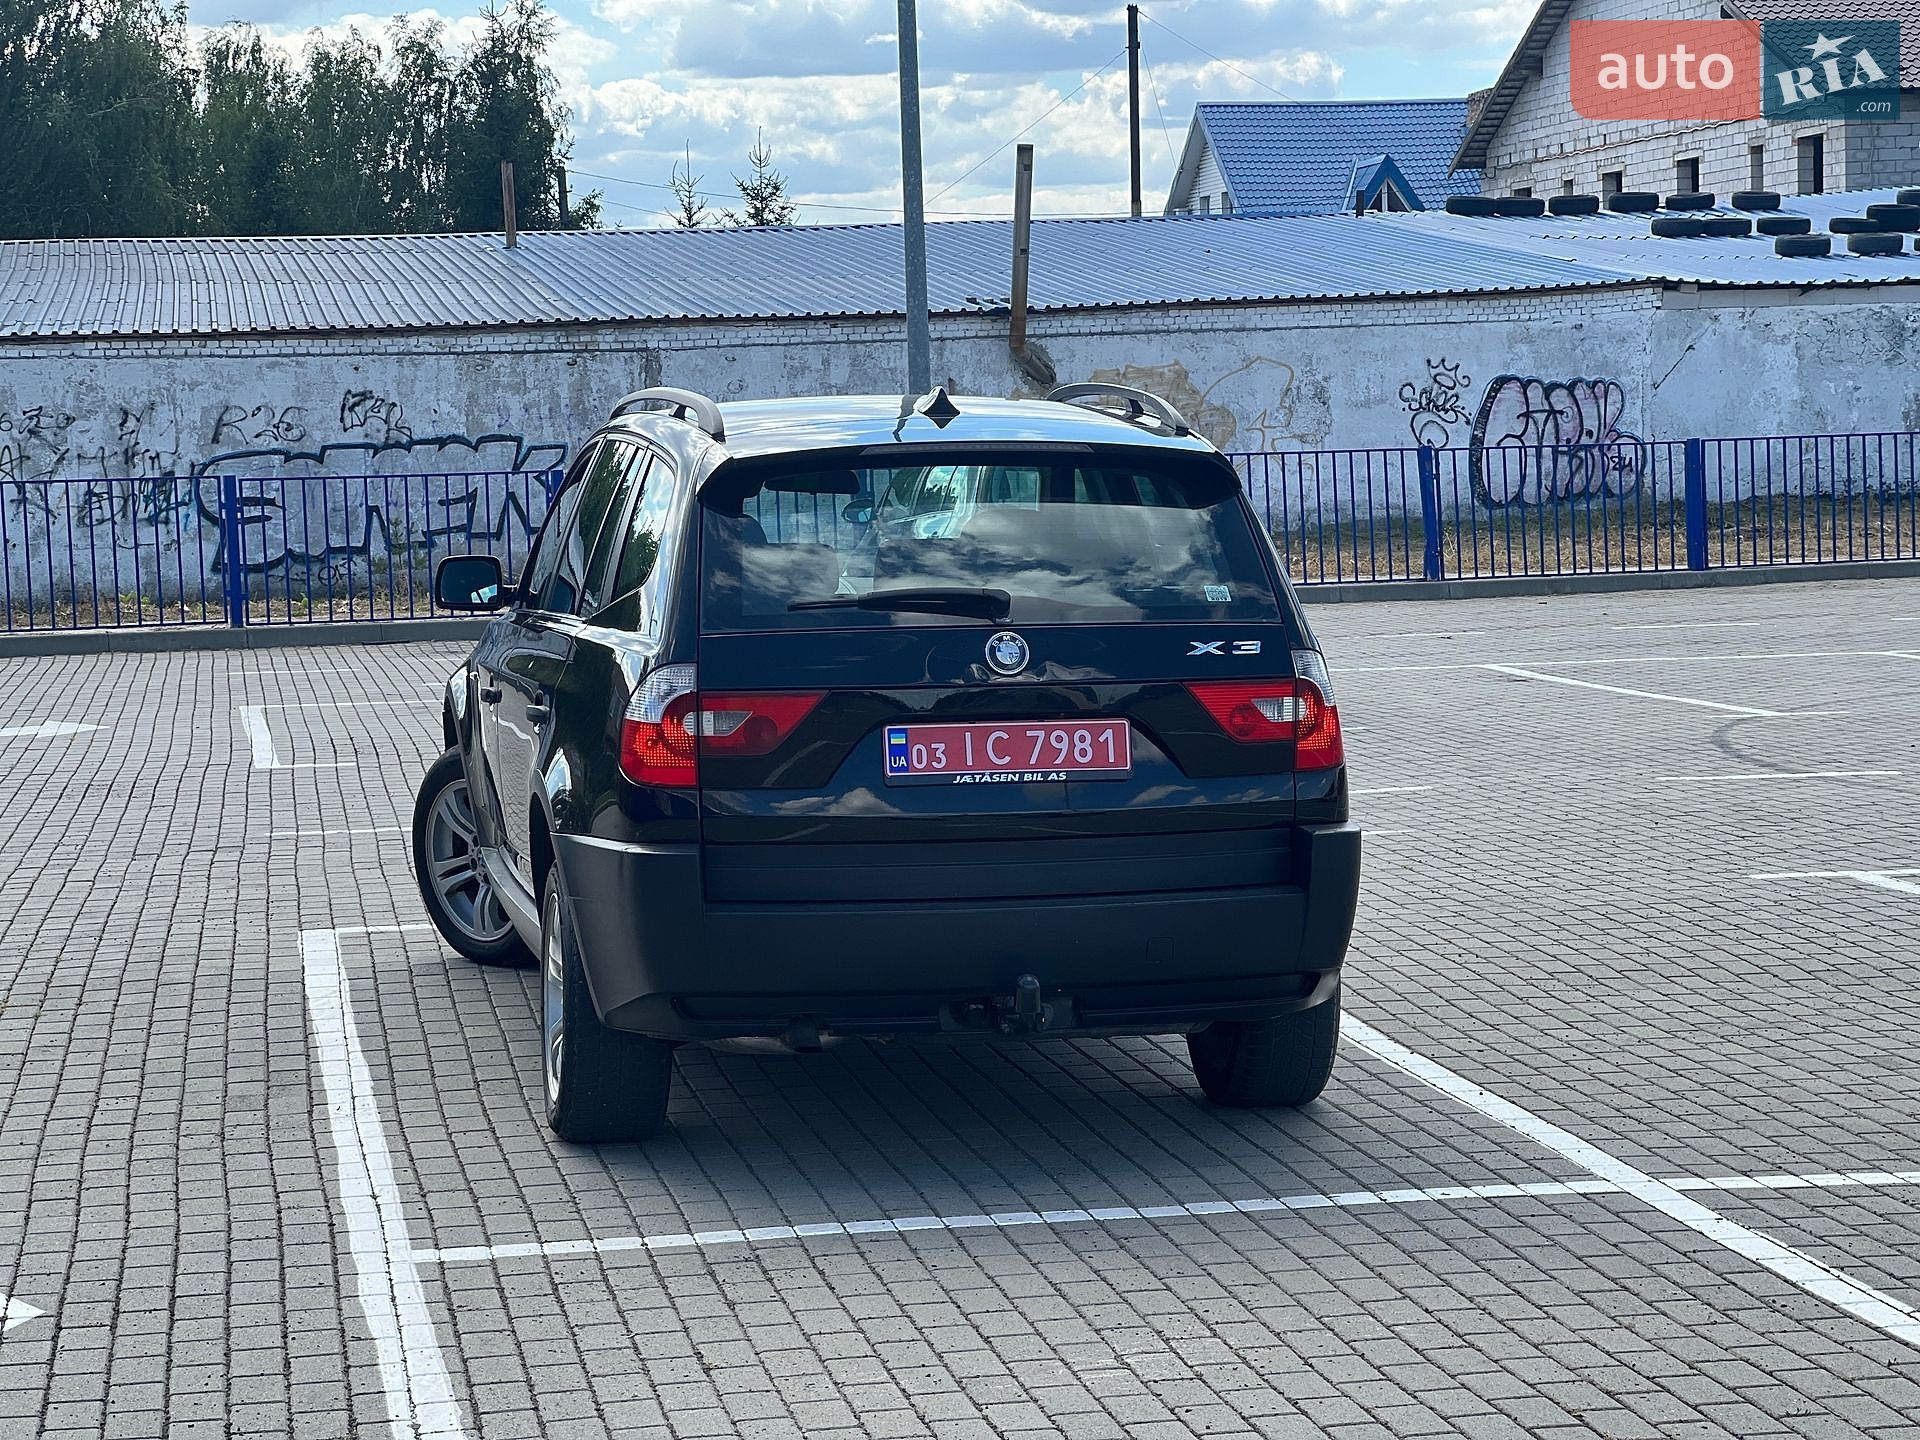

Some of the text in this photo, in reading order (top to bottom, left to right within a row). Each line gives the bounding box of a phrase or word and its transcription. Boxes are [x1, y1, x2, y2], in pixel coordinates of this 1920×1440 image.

[911, 743, 947, 769] 03
[1026, 728, 1115, 765] 7981
[891, 756, 907, 768] UA
[1023, 773, 1044, 782] BIL
[1047, 772, 1067, 781] AS
